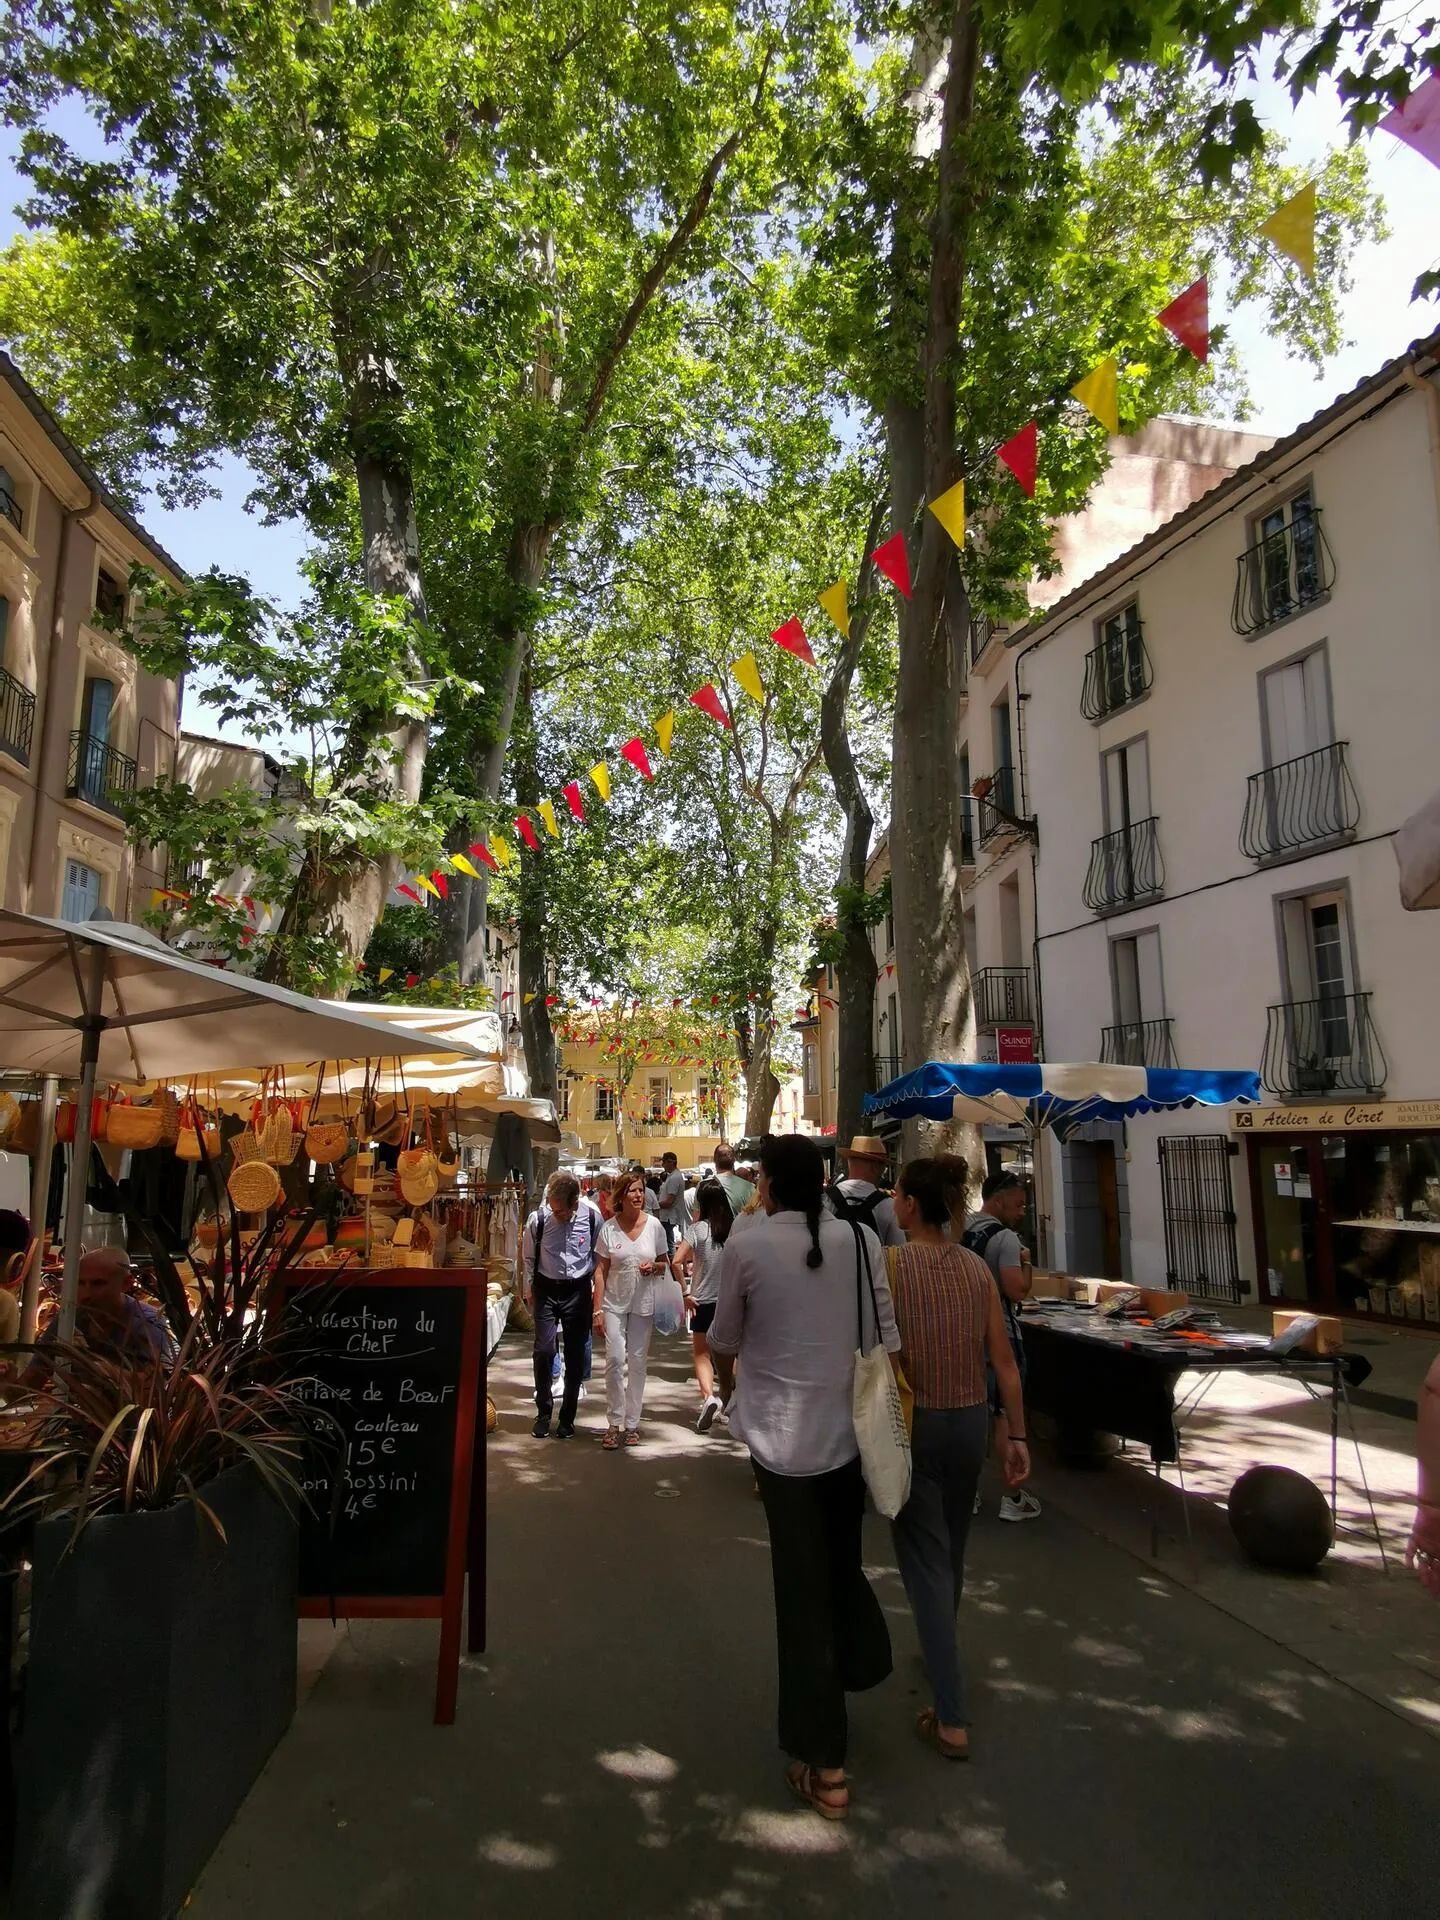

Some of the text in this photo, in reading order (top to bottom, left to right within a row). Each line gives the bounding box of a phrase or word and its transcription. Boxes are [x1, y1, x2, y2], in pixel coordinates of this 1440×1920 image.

[1000, 1034, 1031, 1045] GUINOT
[1262, 1106, 1384, 1127] Atelier de Céret
[415, 1310, 435, 1333] du
[362, 1381, 384, 1401] de
